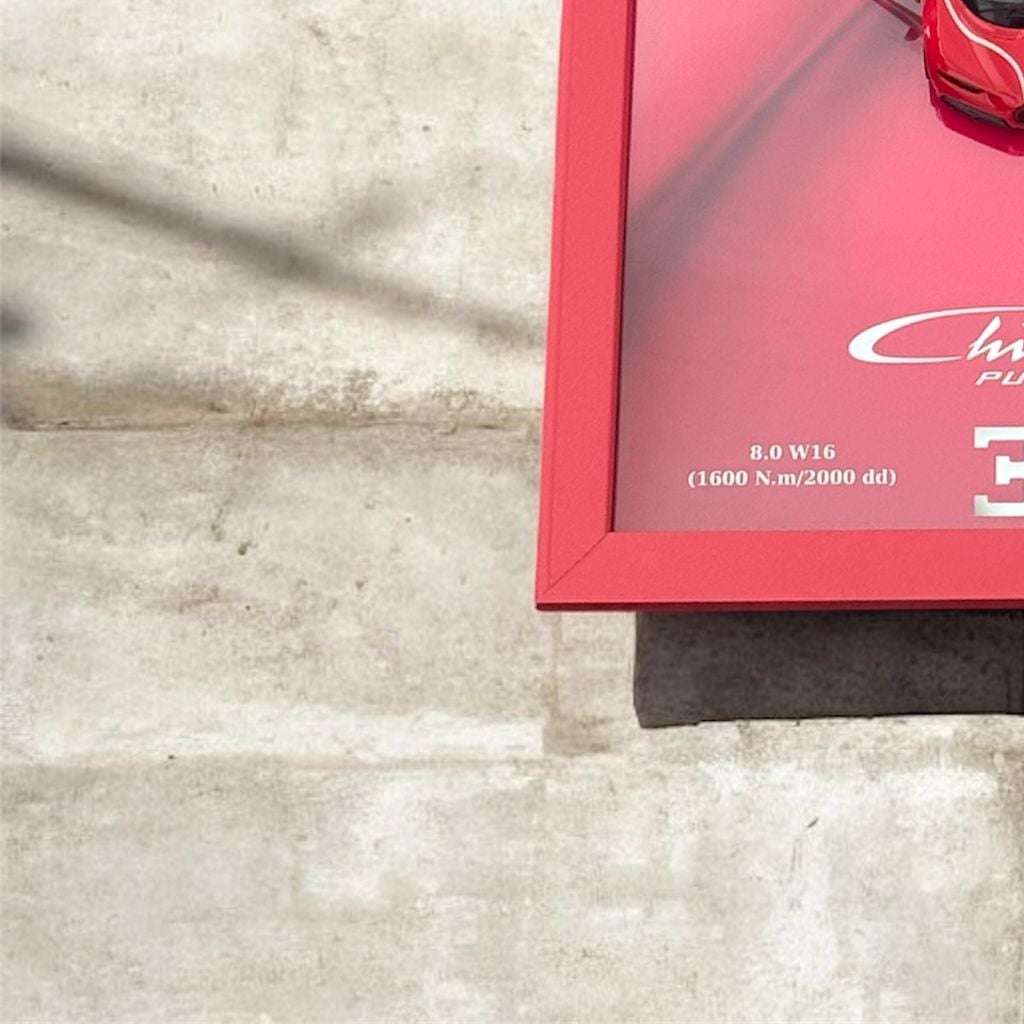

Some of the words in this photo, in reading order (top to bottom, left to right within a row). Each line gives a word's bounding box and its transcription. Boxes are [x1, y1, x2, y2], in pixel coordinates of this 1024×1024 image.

[750, 444, 782, 460] 8.0
[789, 444, 836, 460] W16
[688, 470, 748, 488] (1600
[755, 469, 856, 487] N.m/2000
[862, 469, 897, 486] dd)
